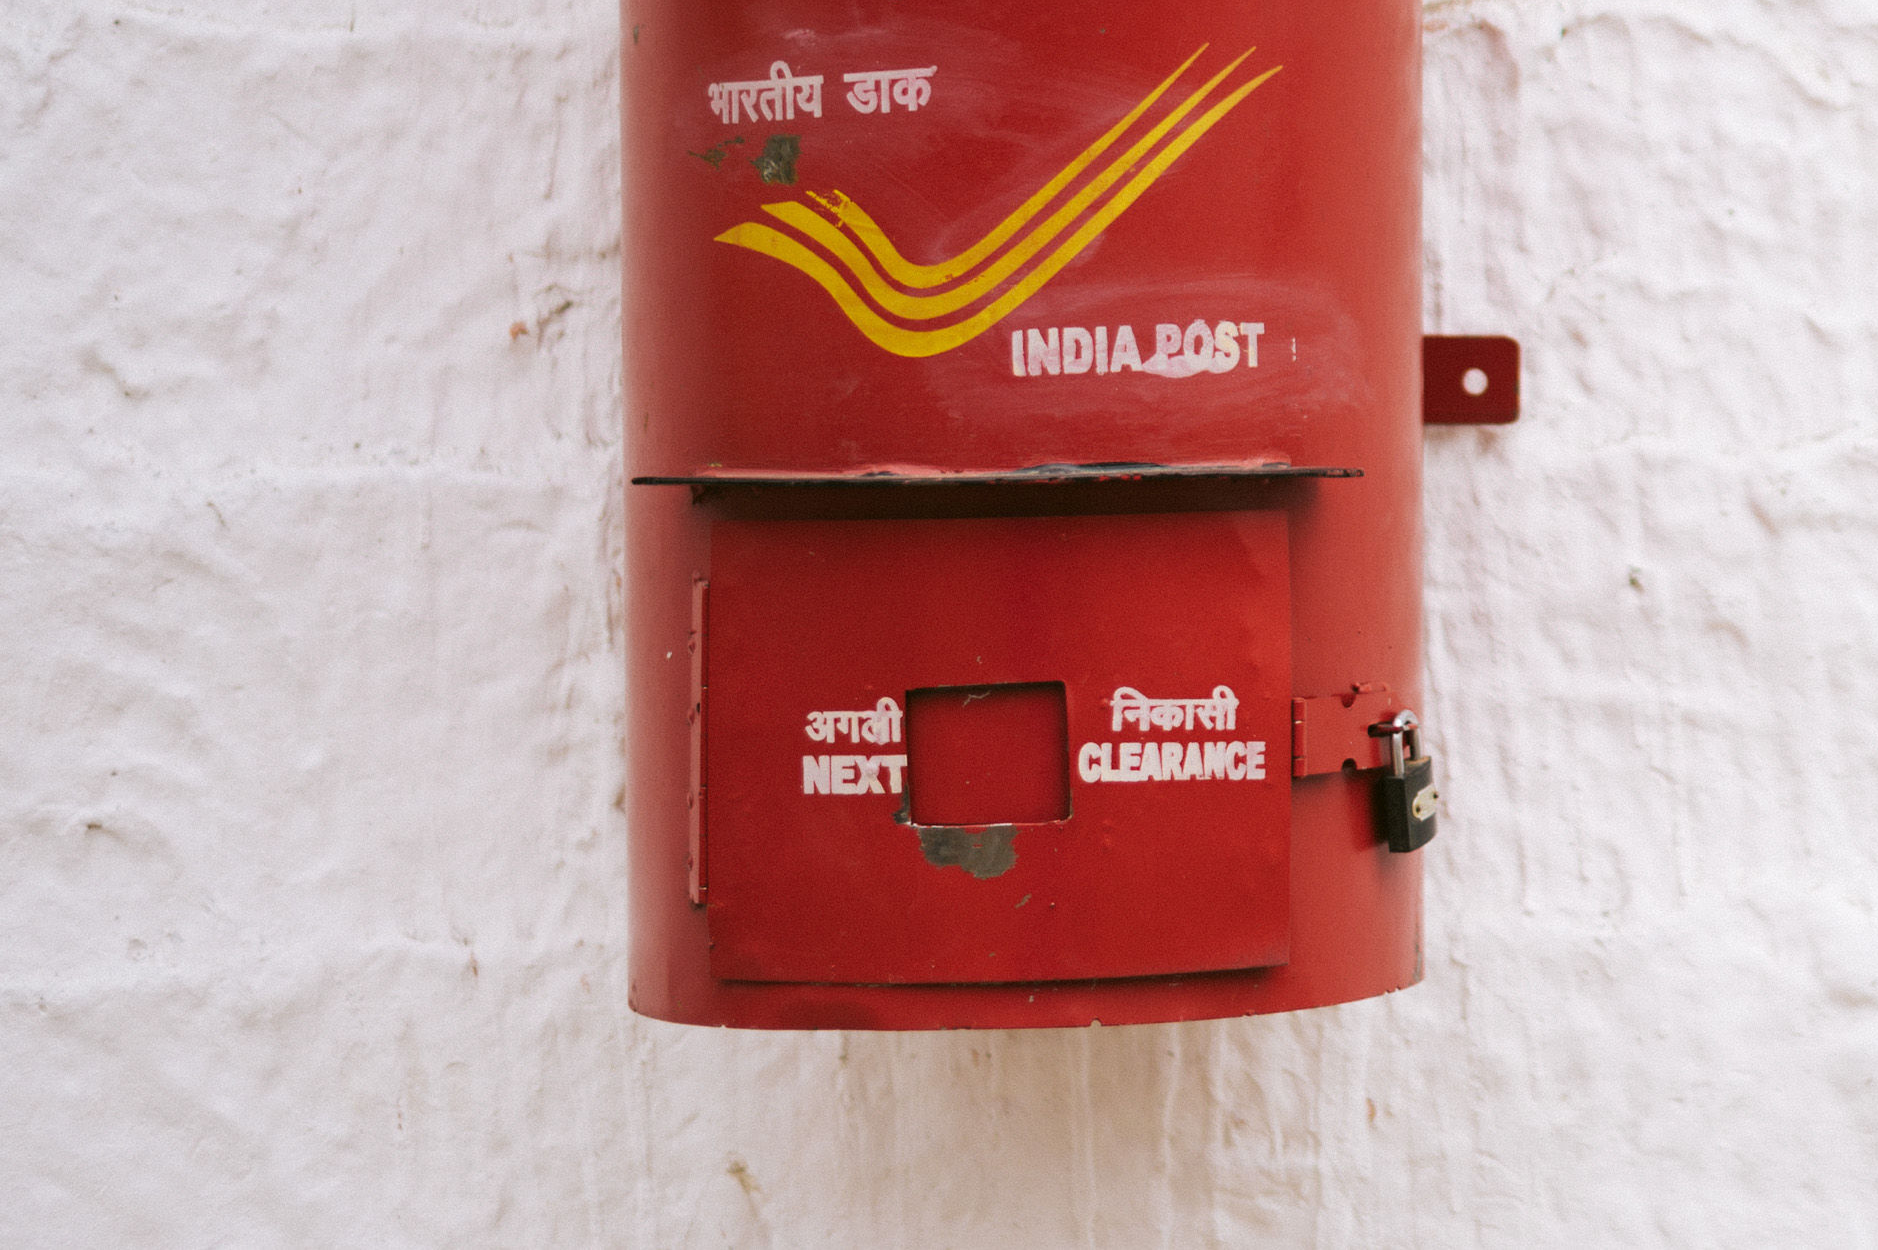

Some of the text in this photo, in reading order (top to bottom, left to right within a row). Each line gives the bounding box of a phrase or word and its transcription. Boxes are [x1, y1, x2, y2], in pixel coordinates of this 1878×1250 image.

[707, 60, 939, 125] भारतीय डाक
[1011, 318, 1266, 379] INDIA POST
[1109, 684, 1241, 733] निकासी
[801, 753, 908, 796] NEXT
[1077, 740, 1267, 784] CLEARANCE
